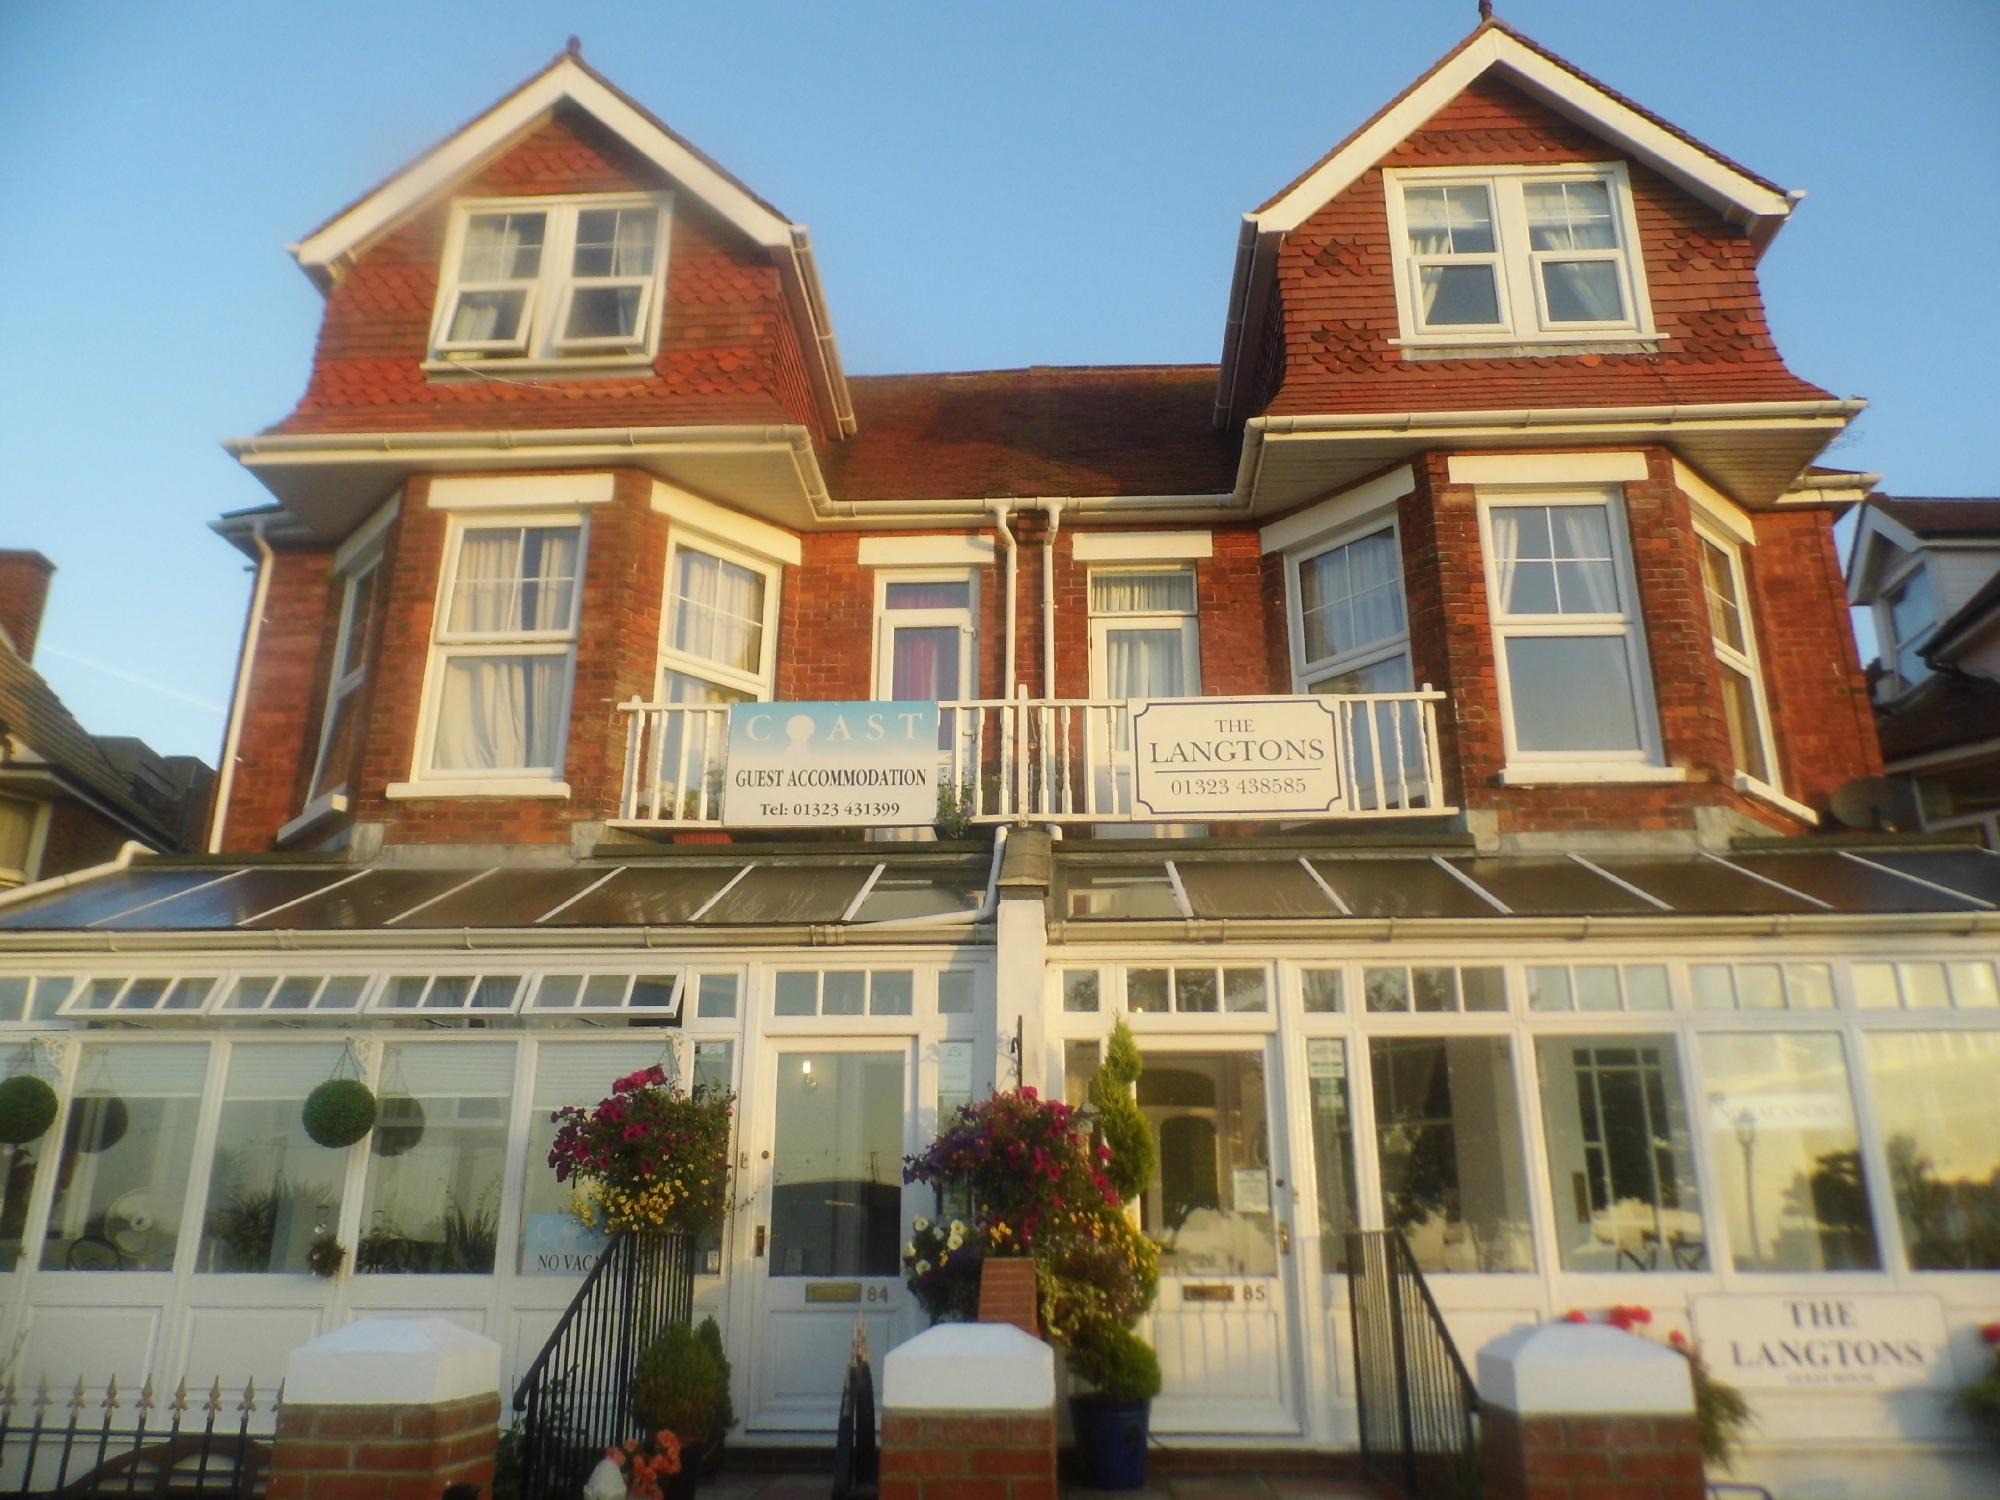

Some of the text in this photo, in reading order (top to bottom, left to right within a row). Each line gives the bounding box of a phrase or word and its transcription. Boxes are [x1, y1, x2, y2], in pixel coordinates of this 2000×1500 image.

[745, 713, 923, 743] COAST
[1214, 719, 1255, 733] THE
[1149, 738, 1325, 764] LANGTONS
[735, 768, 927, 788] GUEST ACCOMMODATION
[1170, 777, 1307, 796] 01323 438585
[760, 802, 900, 817] Tel: 01323 431399
[537, 1254, 560, 1272] NO
[867, 1285, 889, 1303] 84
[1242, 1284, 1266, 1301] 85
[1784, 1300, 1857, 1327] THE
[1731, 1338, 1926, 1367] LANGTONS
